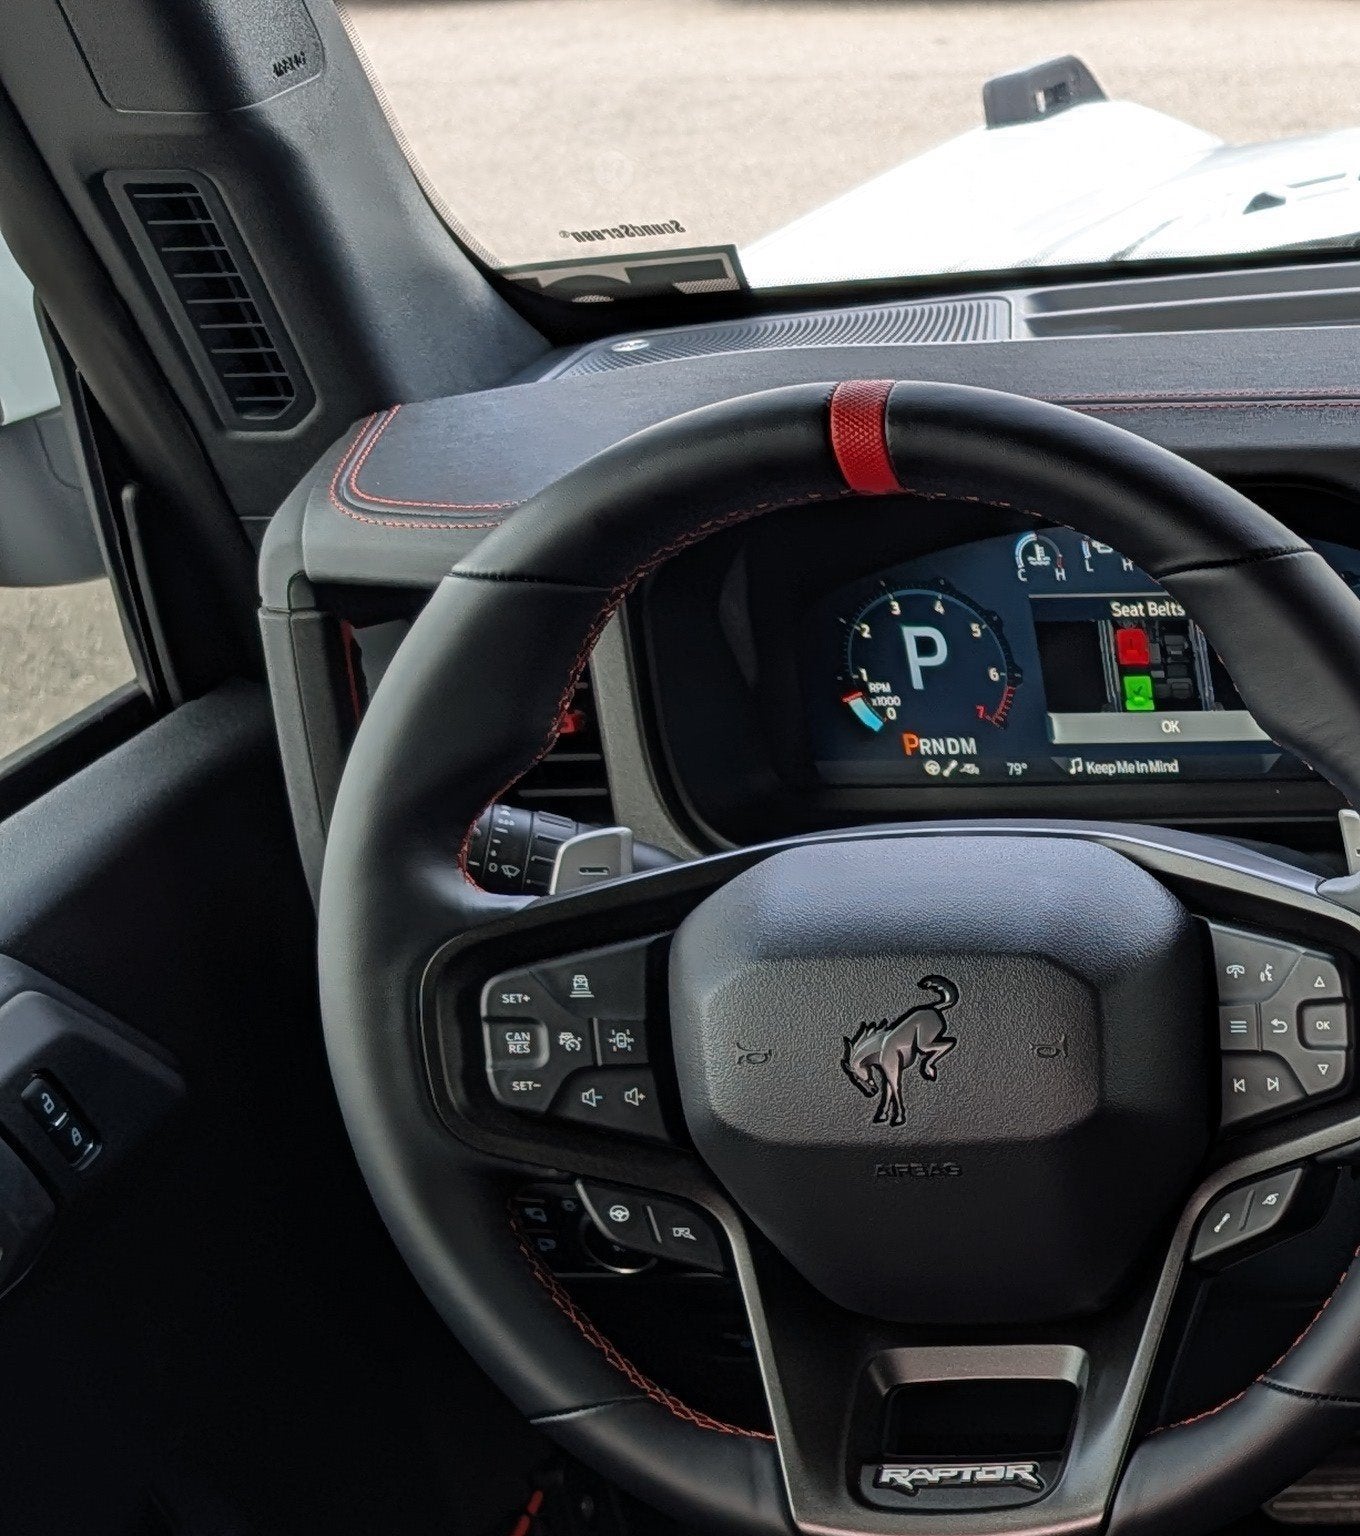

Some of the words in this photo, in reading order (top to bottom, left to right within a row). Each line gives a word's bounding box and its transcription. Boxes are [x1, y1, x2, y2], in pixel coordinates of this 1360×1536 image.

[1017, 568, 1027, 582] C
[1054, 567, 1066, 581] H
[1110, 602, 1144, 618] Seat
[1148, 601, 1186, 617] Belts
[902, 626, 948, 690] P
[868, 682, 891, 694] RPM
[1161, 719, 1181, 734] OK
[1006, 761, 1028, 776] 79°
[1086, 761, 1116, 776] Keep
[1149, 760, 1179, 773] Mind
[1316, 1020, 1331, 1030] OK
[505, 1032, 531, 1042] CAN
[508, 1044, 531, 1054] RES
[878, 1464, 1042, 1492] RAPTOR
